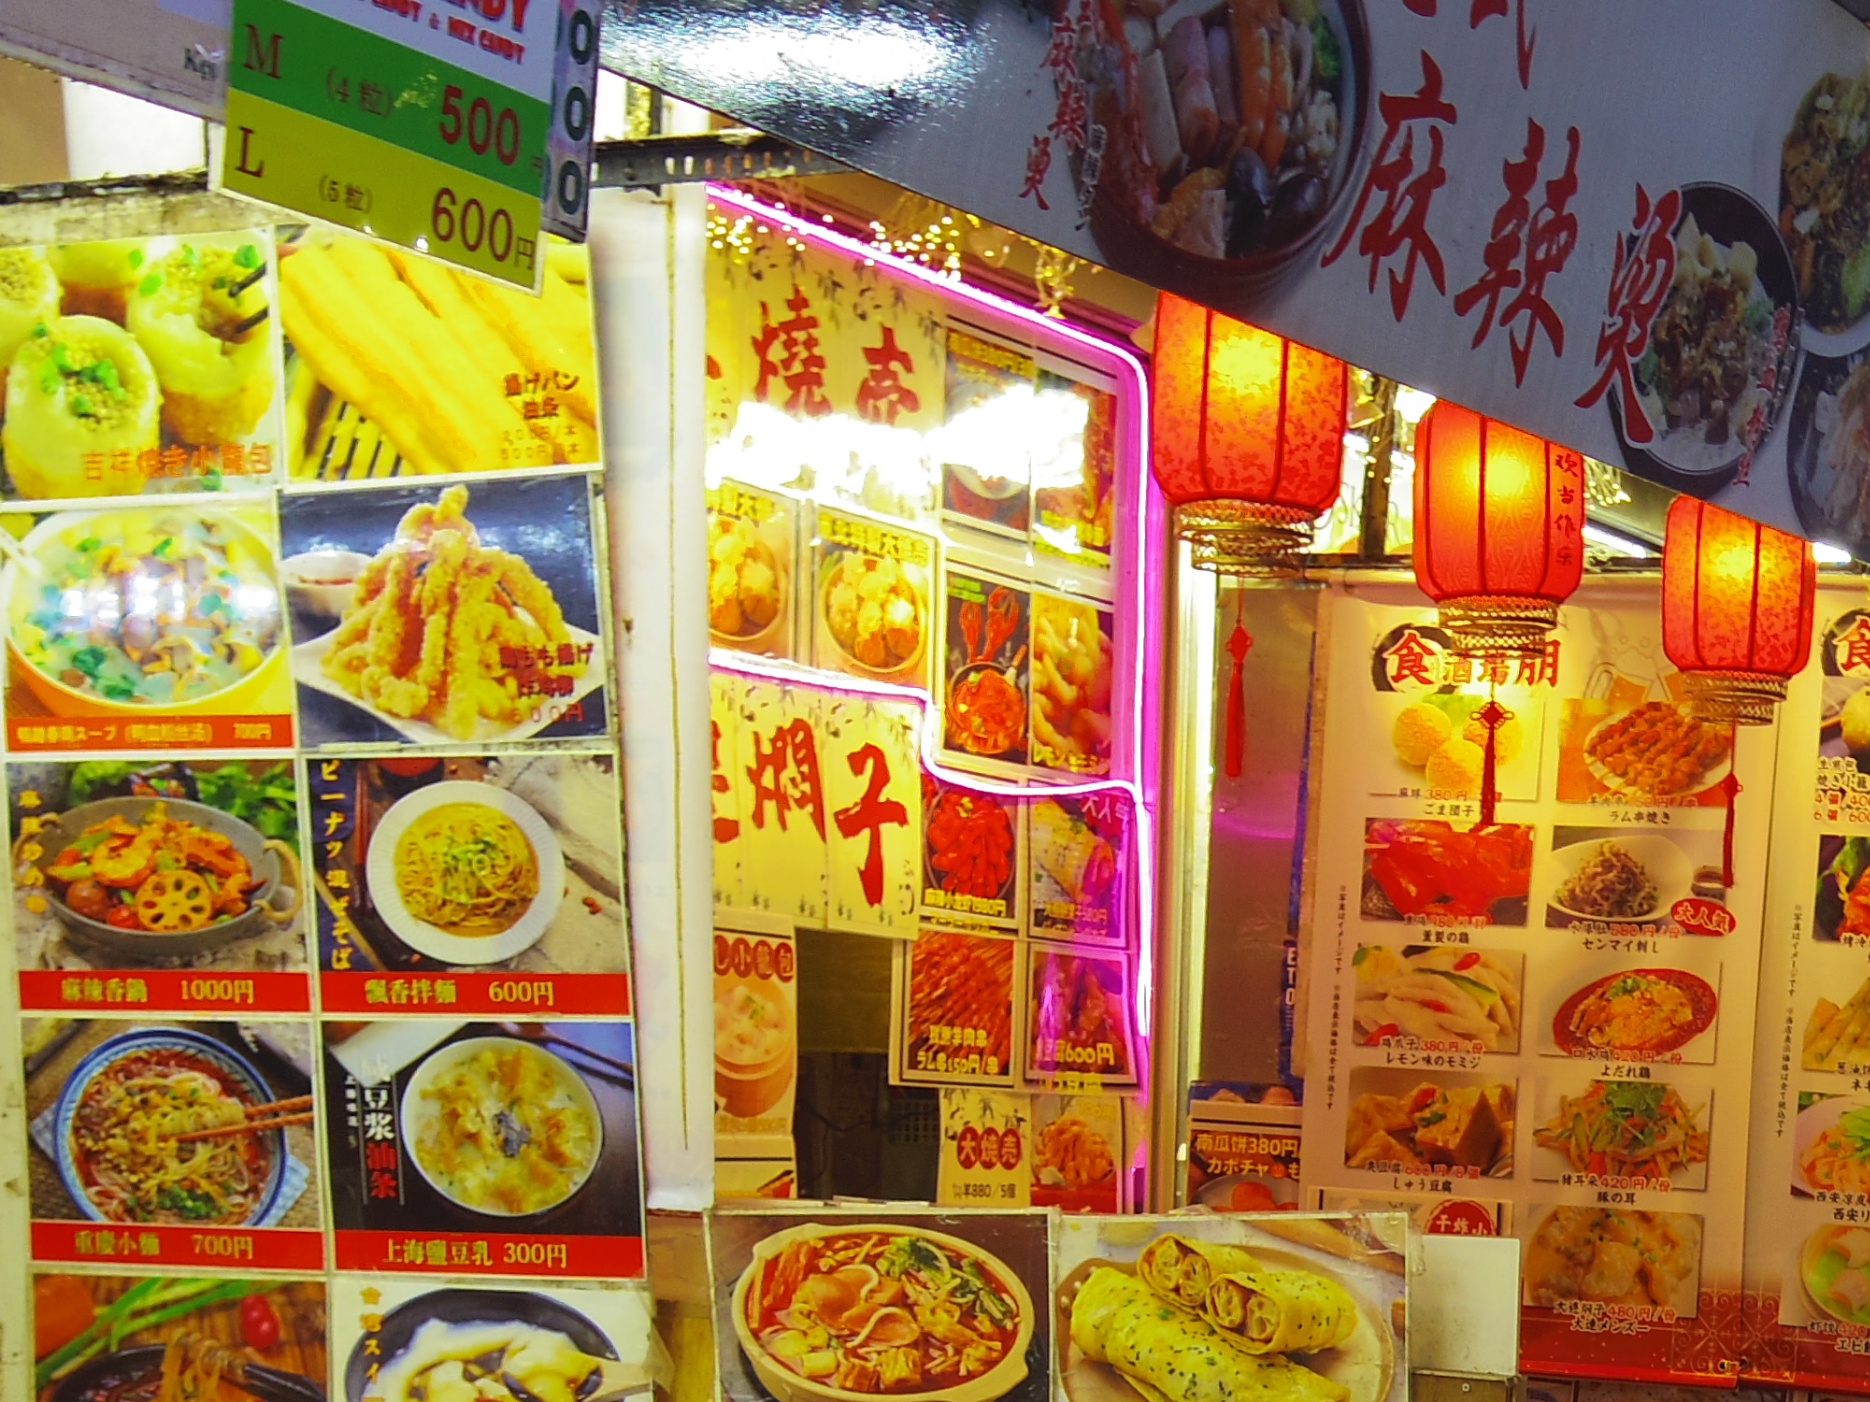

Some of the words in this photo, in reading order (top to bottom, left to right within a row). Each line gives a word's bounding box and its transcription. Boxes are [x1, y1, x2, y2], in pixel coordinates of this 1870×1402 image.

[243, 23, 283, 79] M
[236, 126, 264, 179] L
[432, 186, 537, 272] 600円
[1673, 901, 1731, 934] 大人気
[180, 978, 256, 1004] 1000円
[488, 980, 556, 1006] 600円
[191, 1234, 255, 1260] 700円
[502, 1240, 569, 1269] 300円
